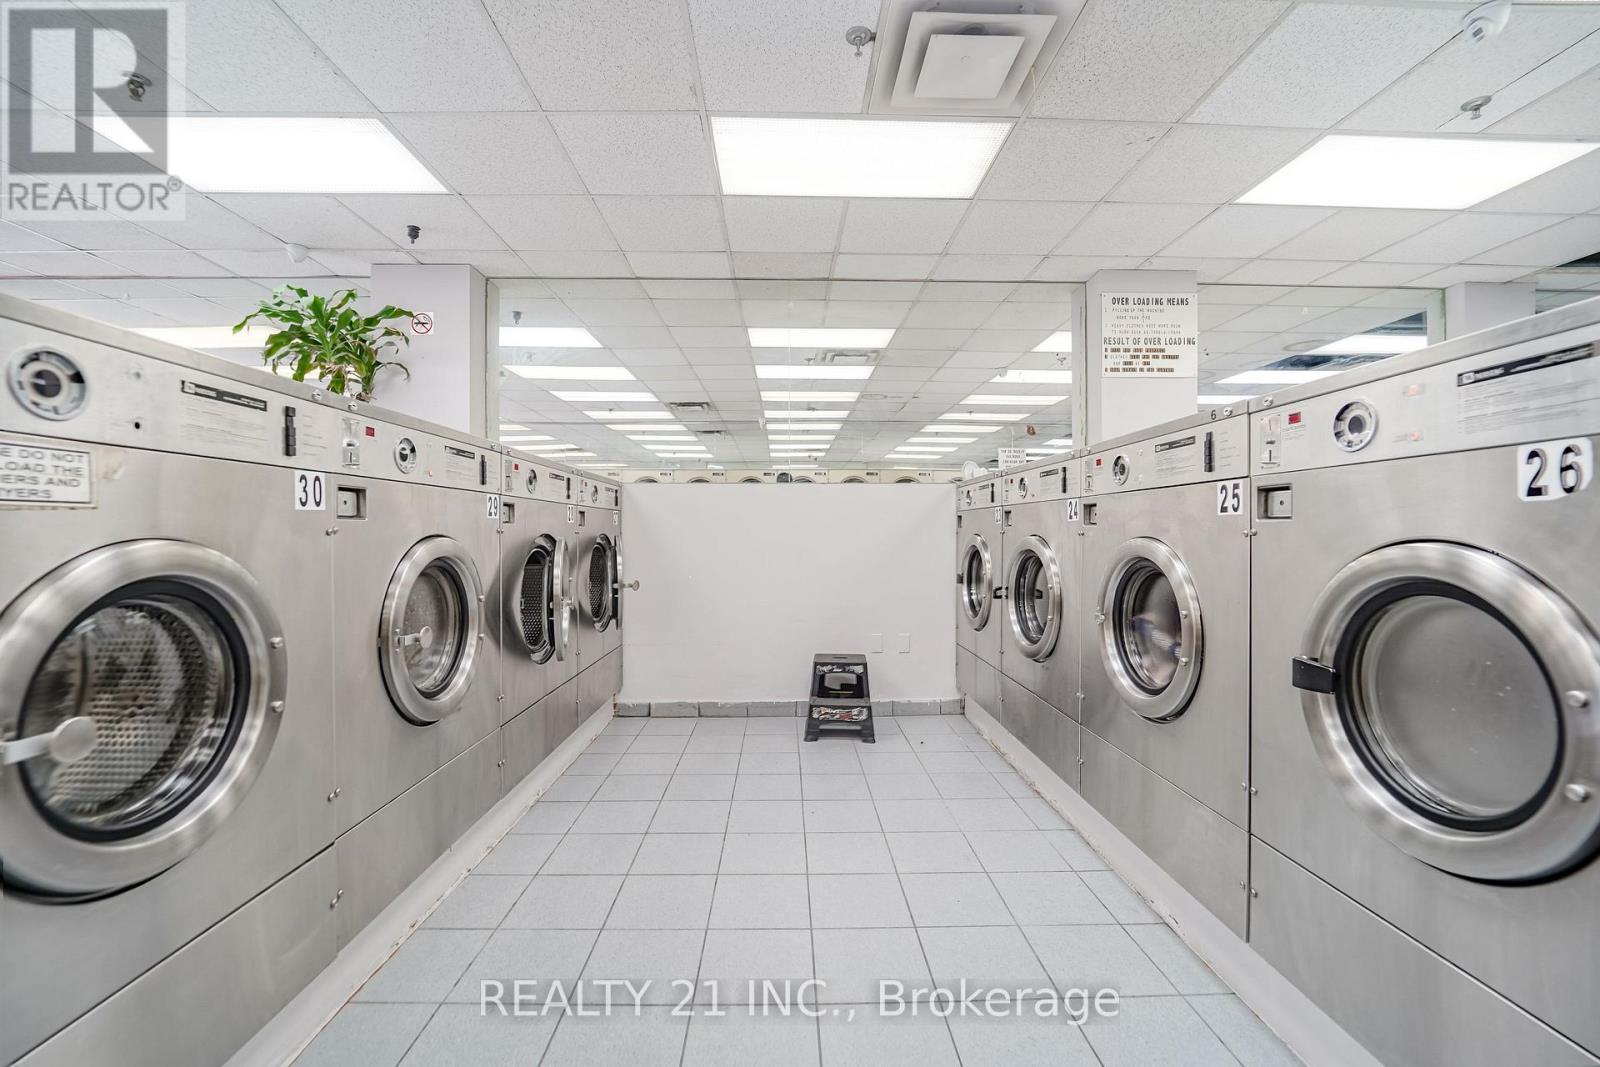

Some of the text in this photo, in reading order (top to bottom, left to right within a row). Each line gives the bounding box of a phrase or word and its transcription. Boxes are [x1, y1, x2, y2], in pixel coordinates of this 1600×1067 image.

[1111, 297, 1190, 306] OVER LOADING MEANS
[1103, 336, 1196, 346] RESULT OF OVER LOADING
[1210, 409, 1217, 420] 6
[18, 449, 45, 460] DO
[51, 452, 85, 464] NOT
[0, 461, 85, 477] OAD THE
[1525, 443, 1583, 498] 26
[44, 477, 81, 488] AND
[299, 474, 323, 508] 30
[1219, 482, 1241, 514] 25
[488, 495, 498, 518] 29
[1068, 499, 1078, 520] 24
